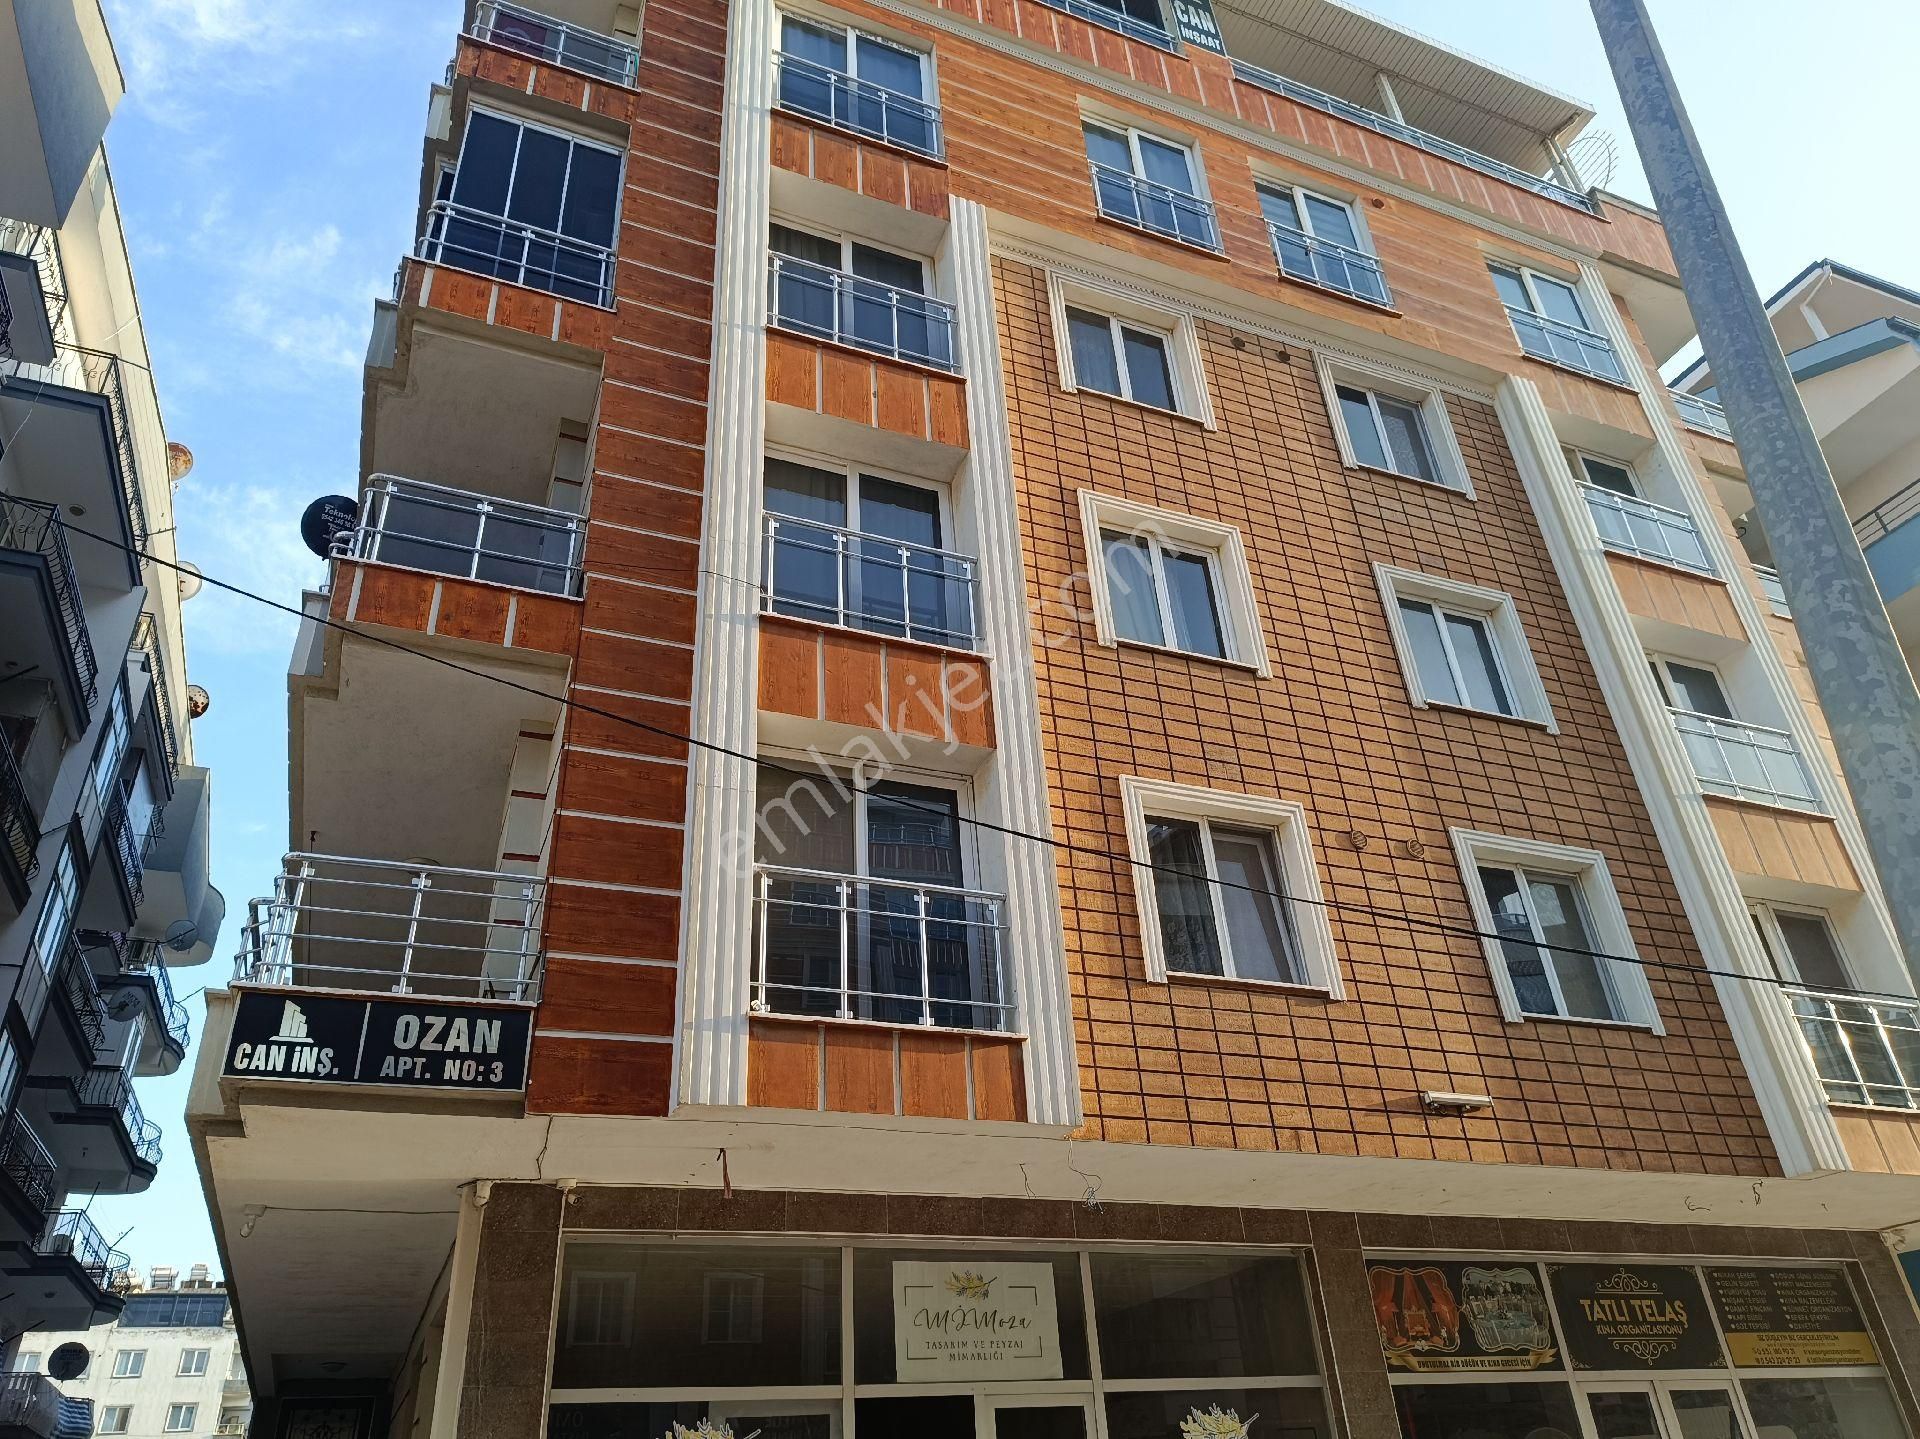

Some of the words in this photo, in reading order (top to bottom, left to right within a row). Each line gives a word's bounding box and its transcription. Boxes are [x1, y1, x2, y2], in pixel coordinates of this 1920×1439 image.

[1173, 0, 1216, 34] CAN
[393, 1014, 502, 1054] OZAN
[233, 1042, 287, 1072] CAN
[380, 1055, 431, 1079] APT.
[1580, 1300, 1630, 1322] TATLI
[1631, 1300, 1689, 1328] TELAŞ
[1596, 1325, 1616, 1335] KINA
[1617, 1323, 1683, 1335] ORGANİZASYONU
[925, 1341, 969, 1350] TASARIM
[974, 1341, 985, 1349] VE
[990, 1340, 1024, 1349] PEYZAJ
[949, 1350, 1004, 1361] MİMARLIĞI
